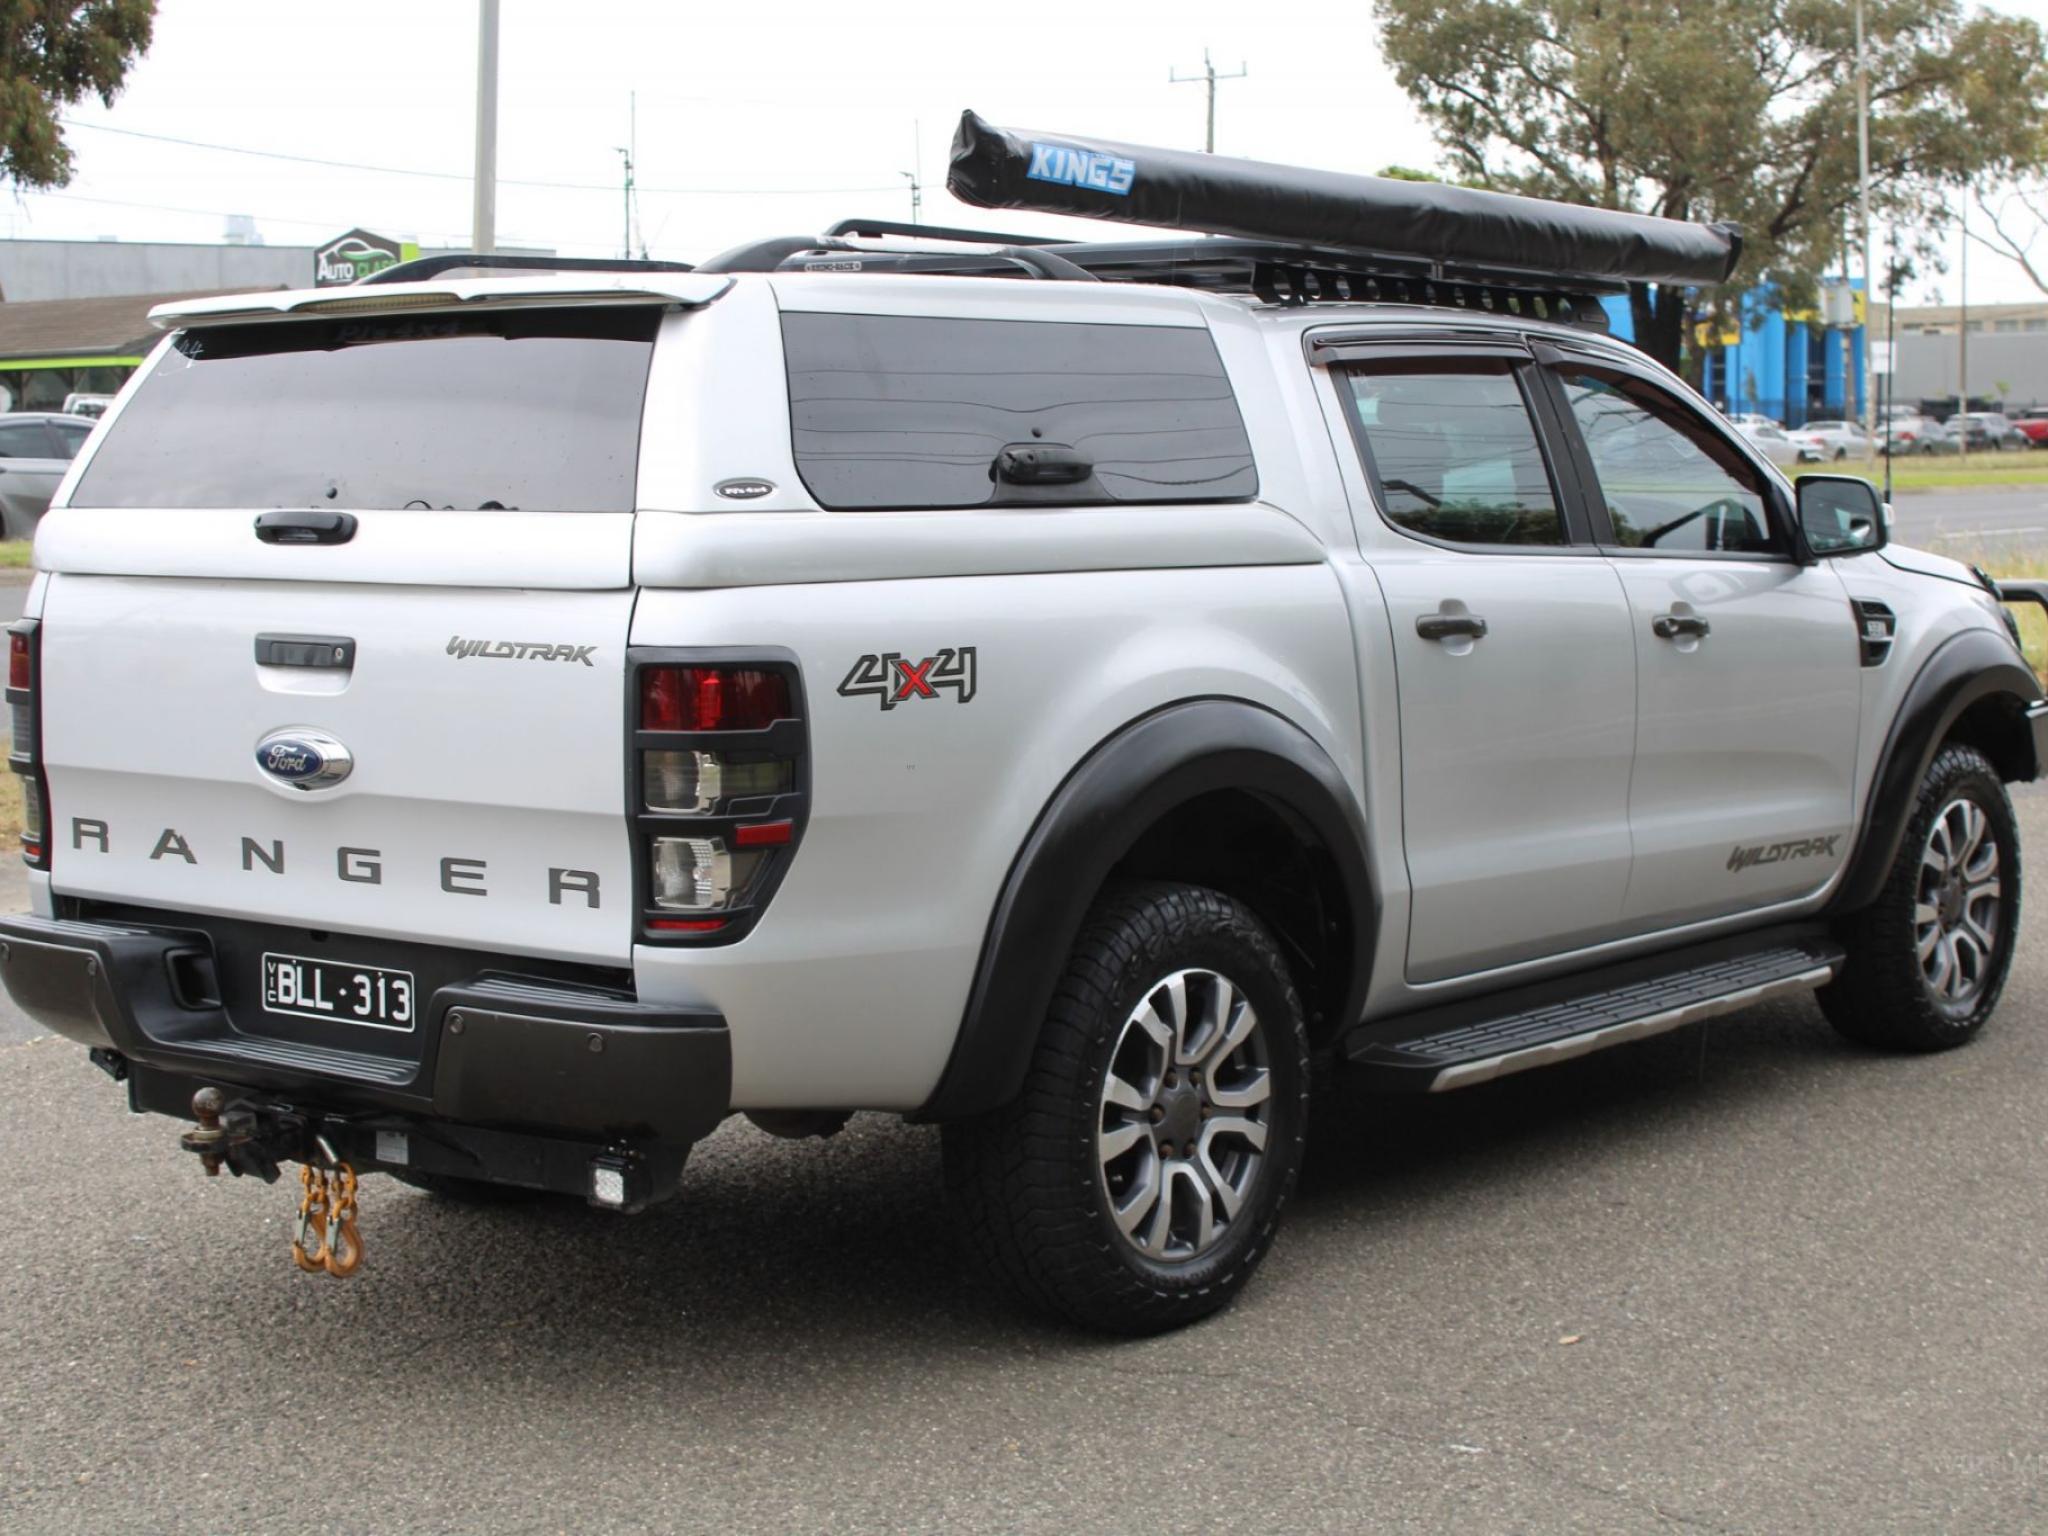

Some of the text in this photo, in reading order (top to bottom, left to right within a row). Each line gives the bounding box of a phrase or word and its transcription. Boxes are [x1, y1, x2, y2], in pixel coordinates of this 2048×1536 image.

[1030, 145, 1135, 192] KINGS
[317, 256, 354, 280] AUTO
[446, 635, 598, 667] WILDTRAK
[267, 744, 308, 772] Ford
[71, 816, 601, 909] RANGER
[1726, 834, 1842, 873] WILDTRAK
[267, 961, 277, 1003] VIC
